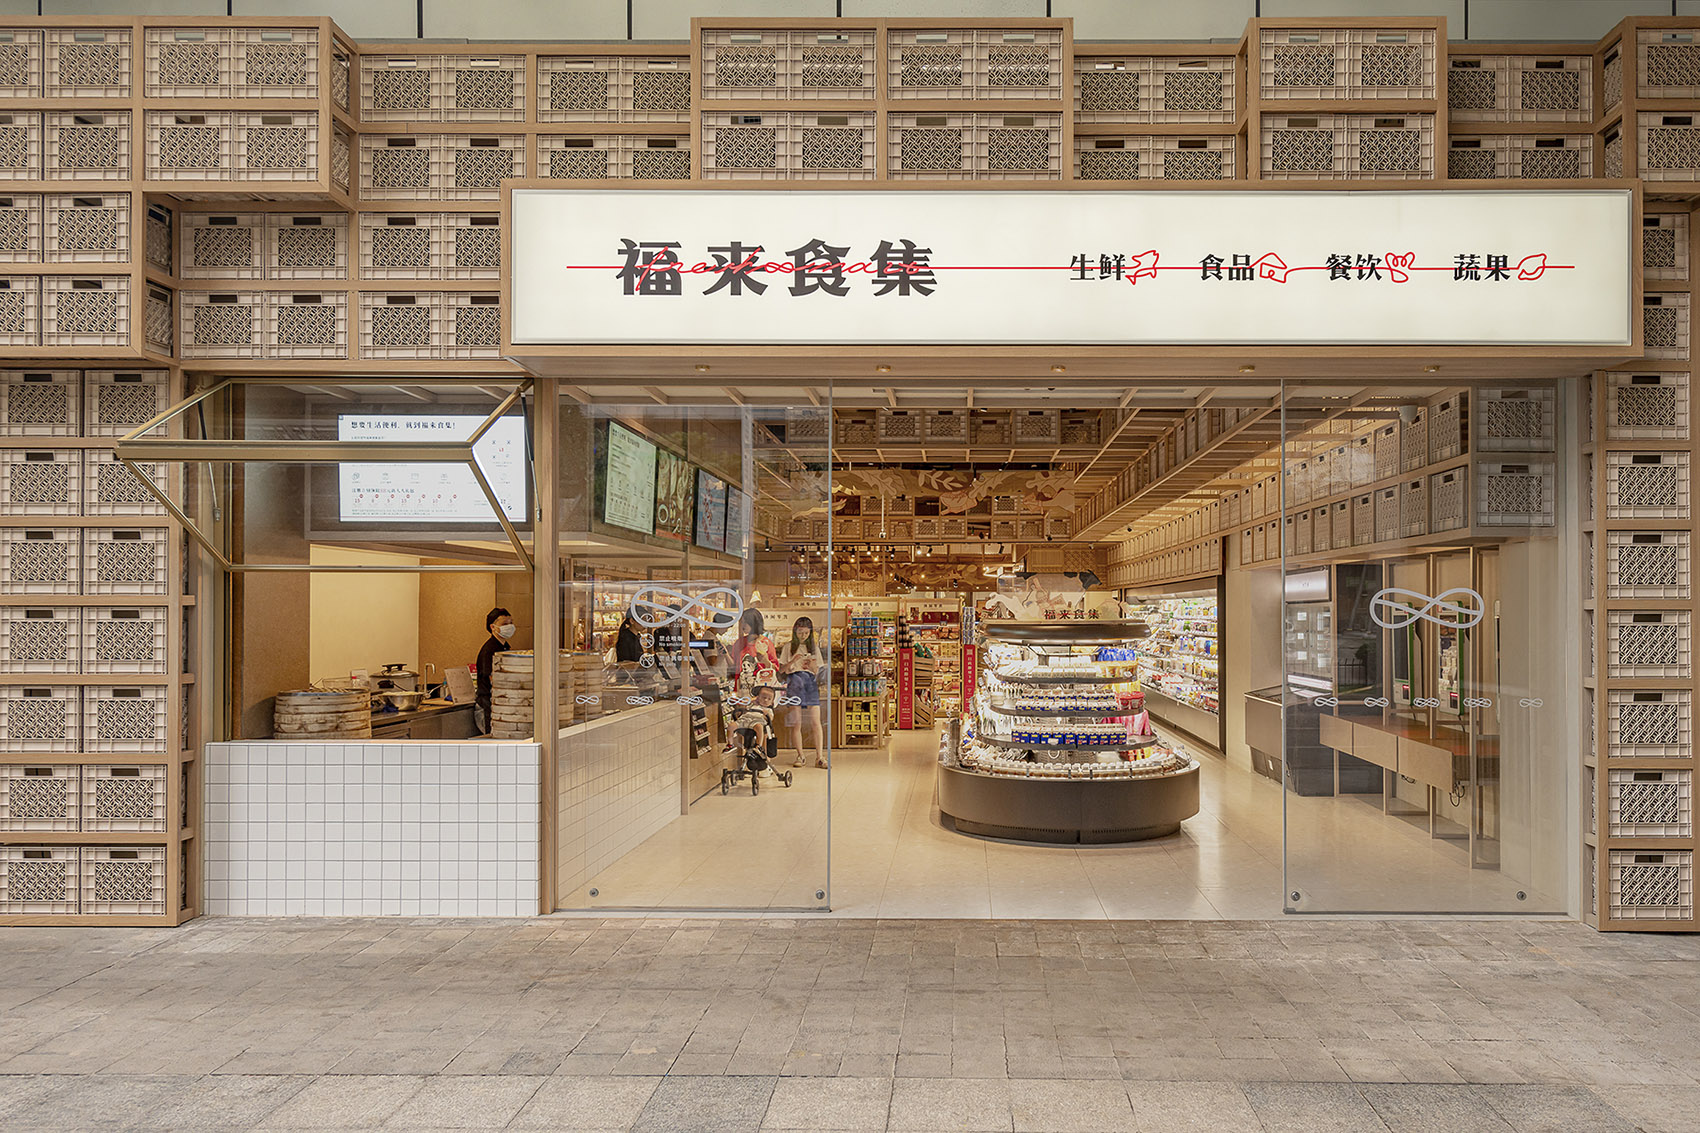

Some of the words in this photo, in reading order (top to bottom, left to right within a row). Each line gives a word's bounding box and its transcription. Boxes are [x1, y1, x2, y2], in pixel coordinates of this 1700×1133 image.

[616, 238, 937, 297] 福来食集
[1070, 253, 1127, 282] 生鲜
[1198, 253, 1255, 282] 食品
[1325, 253, 1382, 282] 餐饮
[1453, 253, 1511, 282] 蔬果
[1044, 609, 1100, 620] 福来食集
